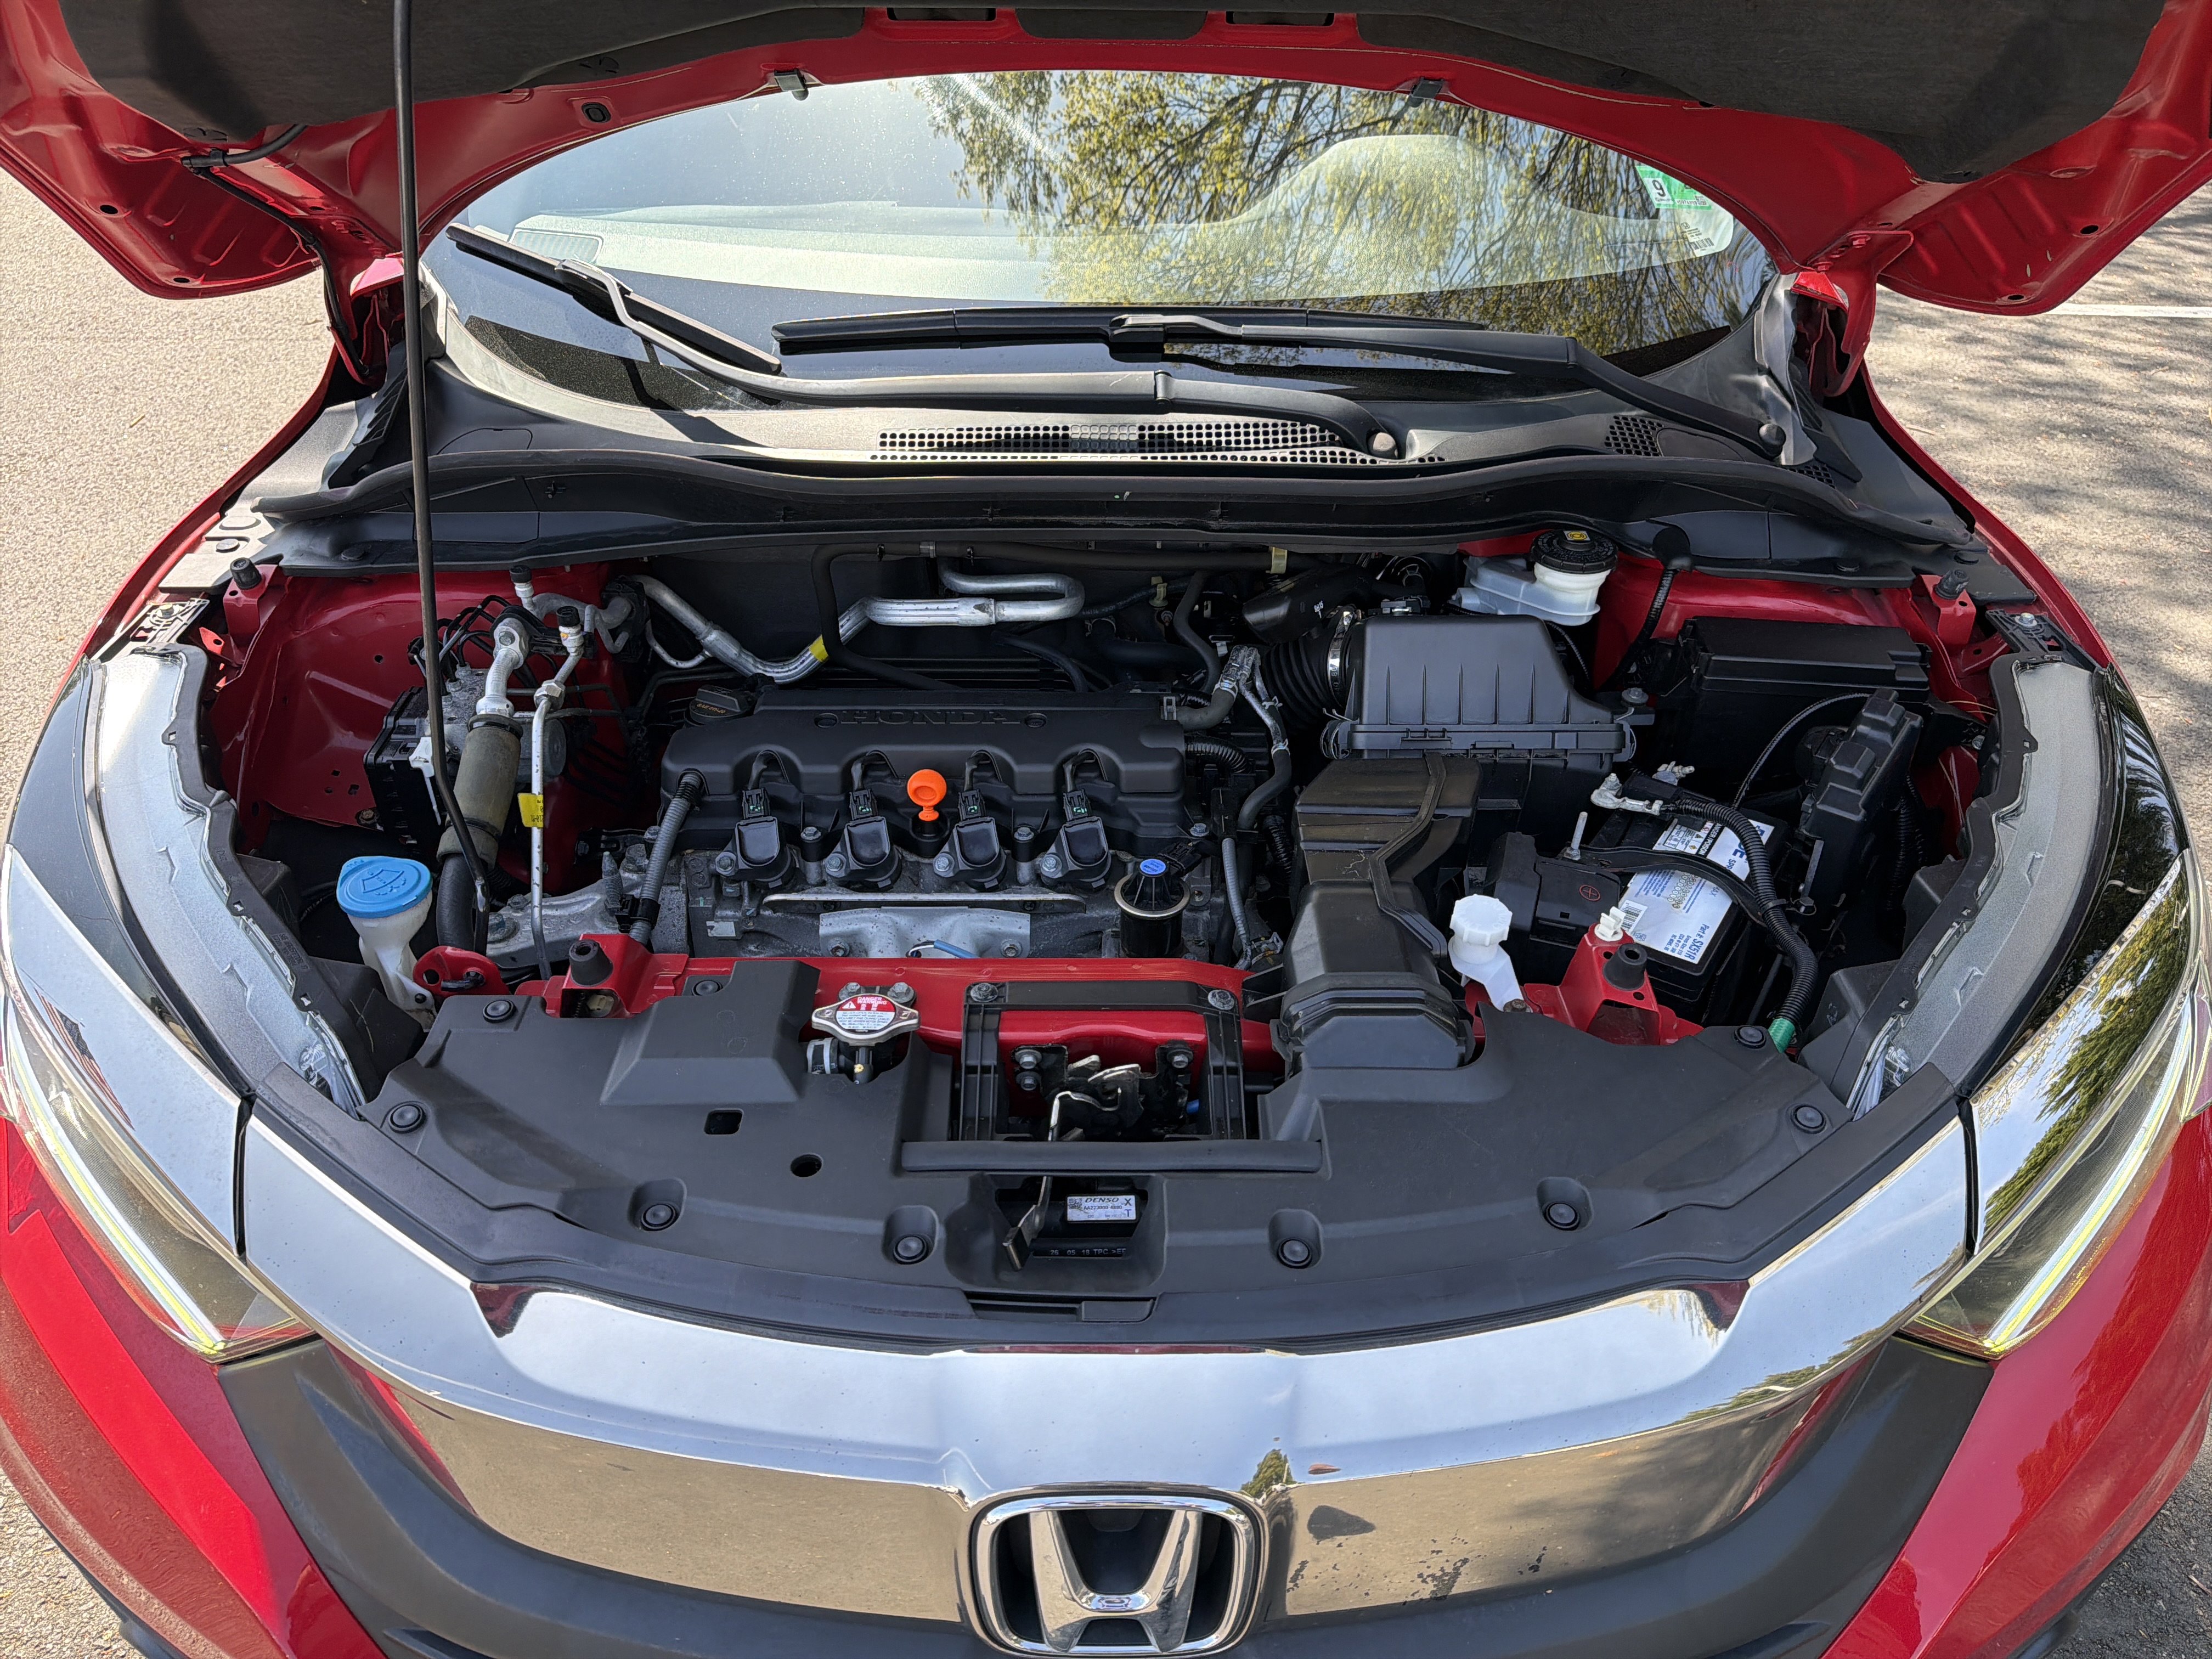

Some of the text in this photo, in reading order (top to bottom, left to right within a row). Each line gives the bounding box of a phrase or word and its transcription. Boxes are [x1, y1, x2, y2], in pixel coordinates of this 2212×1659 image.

[1652, 179, 1666, 197] 9
[840, 710, 1021, 725] HONDA
[1709, 823, 1722, 838] ANGER
[1699, 923, 1710, 934] Part
[1684, 940, 1703, 961] SX51R
[1124, 1209, 1132, 1217] T
